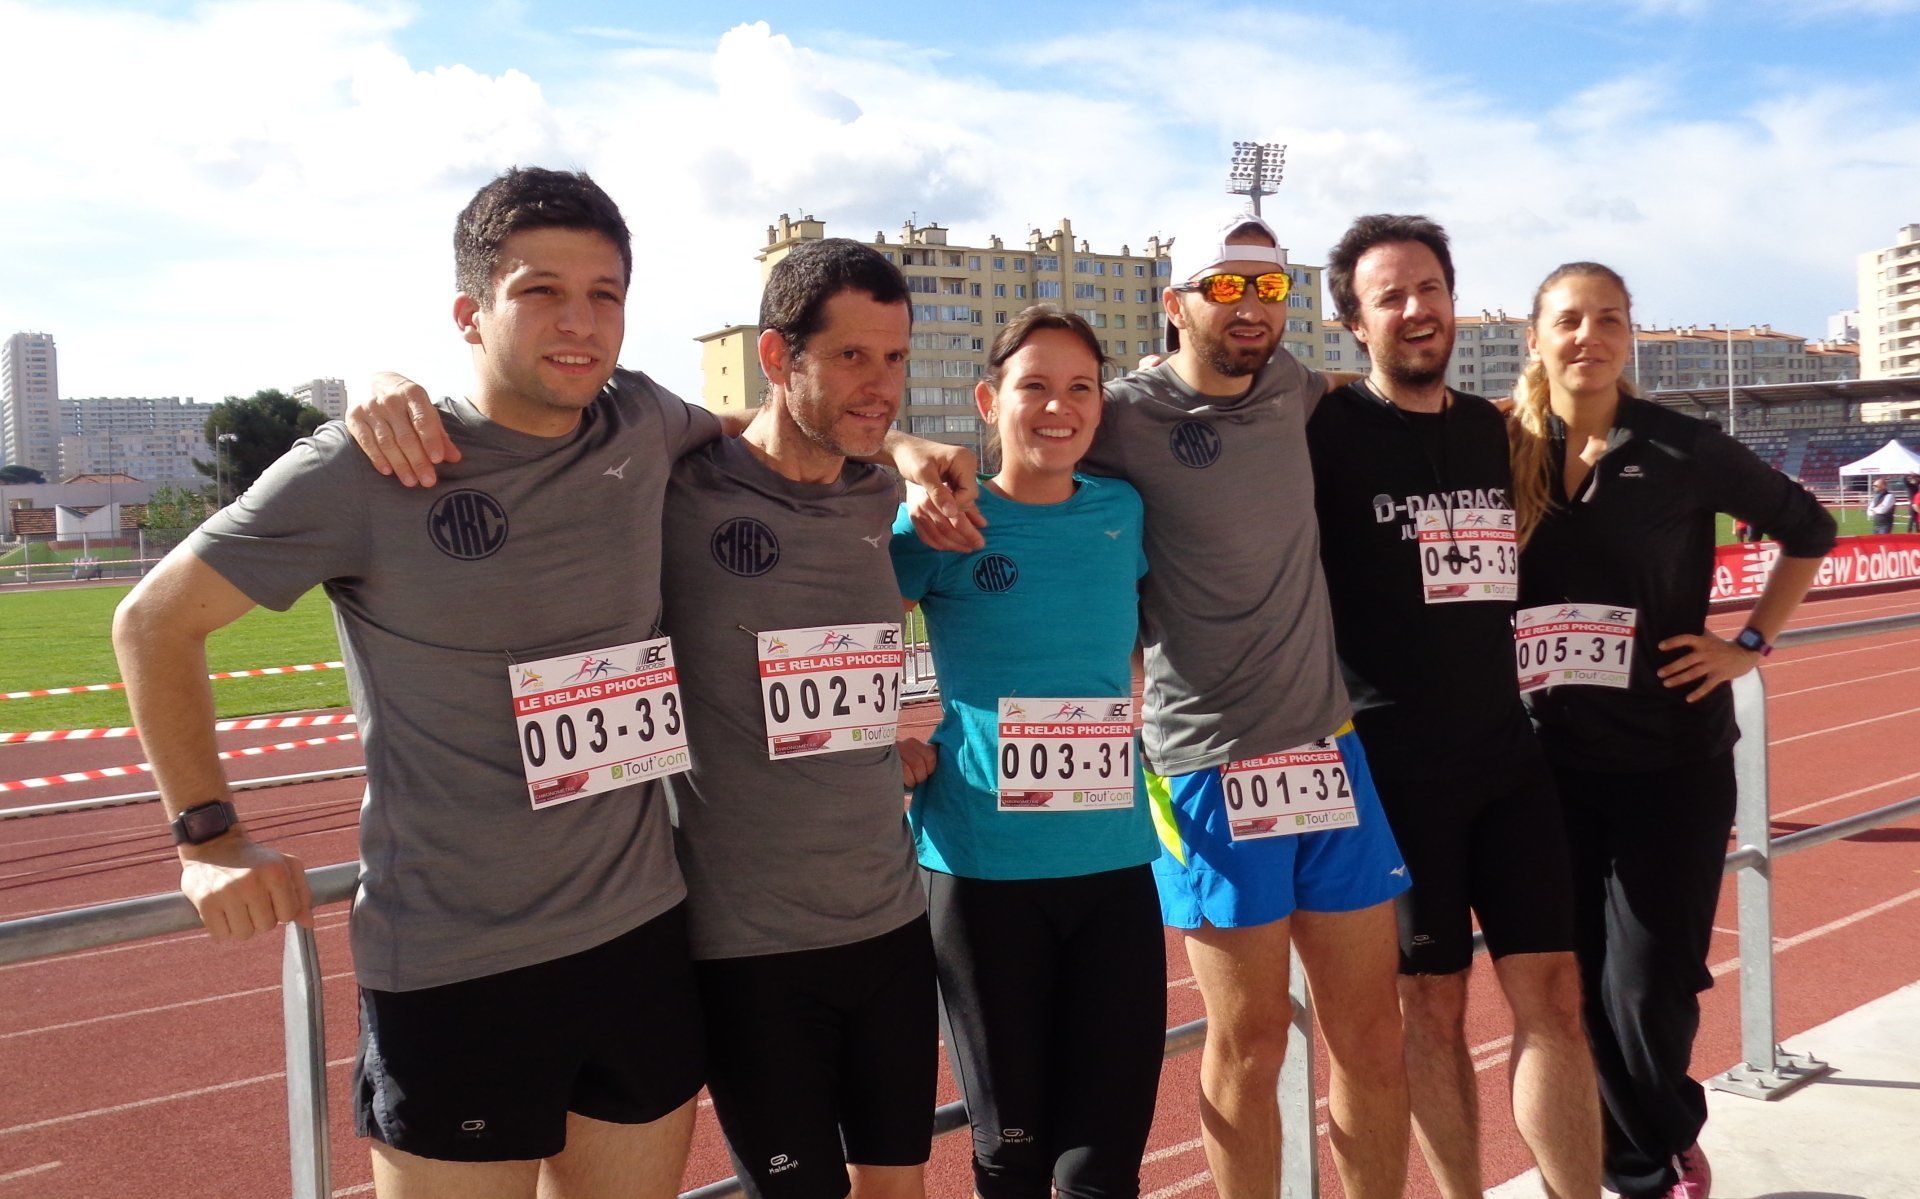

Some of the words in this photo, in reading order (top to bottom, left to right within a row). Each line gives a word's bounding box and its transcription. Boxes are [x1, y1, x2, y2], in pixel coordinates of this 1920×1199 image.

[433, 492, 502, 557] MRC
[714, 520, 776, 574] MRC
[975, 555, 1016, 592] MRC
[1519, 629, 1532, 637] LE
[1532, 623, 1569, 634] RELAIS
[1571, 624, 1631, 634] PHOCEEN
[766, 662, 787, 674] LE
[790, 656, 844, 671] RELAIS
[846, 653, 900, 666] PHOCEEN
[1519, 637, 1627, 670] 005-31
[519, 697, 541, 712] LE
[544, 685, 602, 707] RELAIS
[605, 672, 673, 694] PHOCEEN
[769, 672, 899, 724] 002-31
[524, 691, 681, 768] 003-33
[1003, 725, 1021, 735] LE
[1024, 725, 1075, 735] RELAIS
[1078, 725, 1131, 735] PHOCEEN
[1002, 742, 1129, 780] 003-31
[1242, 755, 1287, 769] RELAIS
[1289, 752, 1338, 763] PHOCEEN
[1226, 767, 1350, 810] 001-32
